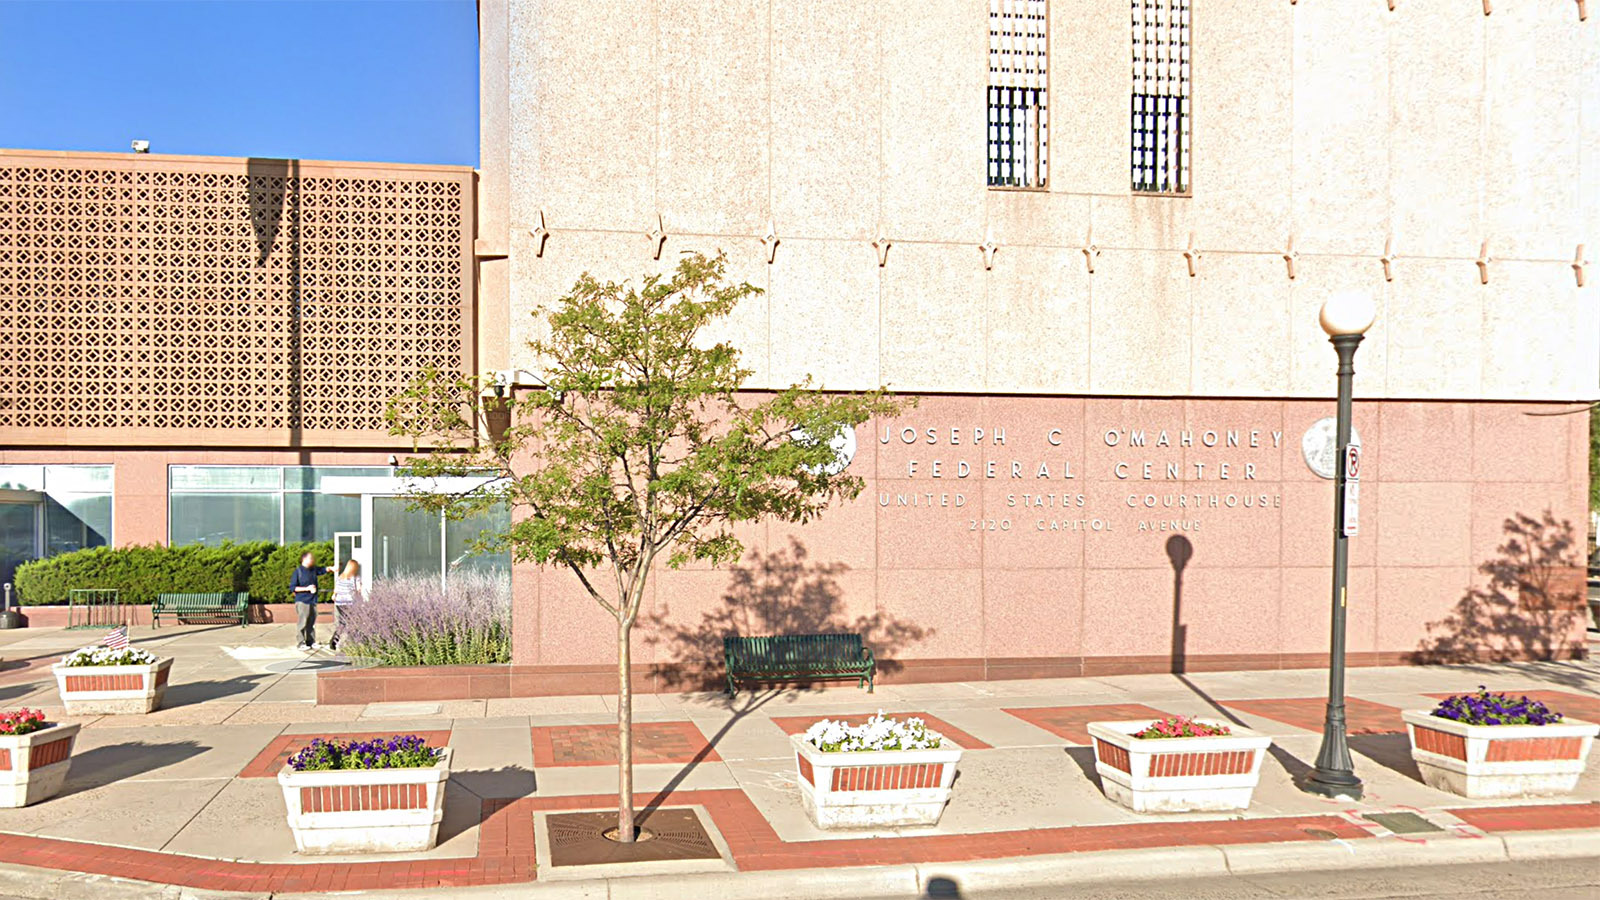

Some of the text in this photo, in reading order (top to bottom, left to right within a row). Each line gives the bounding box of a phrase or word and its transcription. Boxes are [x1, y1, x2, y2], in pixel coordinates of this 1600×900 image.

[879, 426, 1282, 448] JOSEPH C O'MAHONEY
[908, 460, 1256, 480] FEDERAL CENTER
[879, 493, 1281, 508] UNITED STATES COURTHOUSE
[970, 519, 1201, 531] 2120 CAPITOL AVENUE
